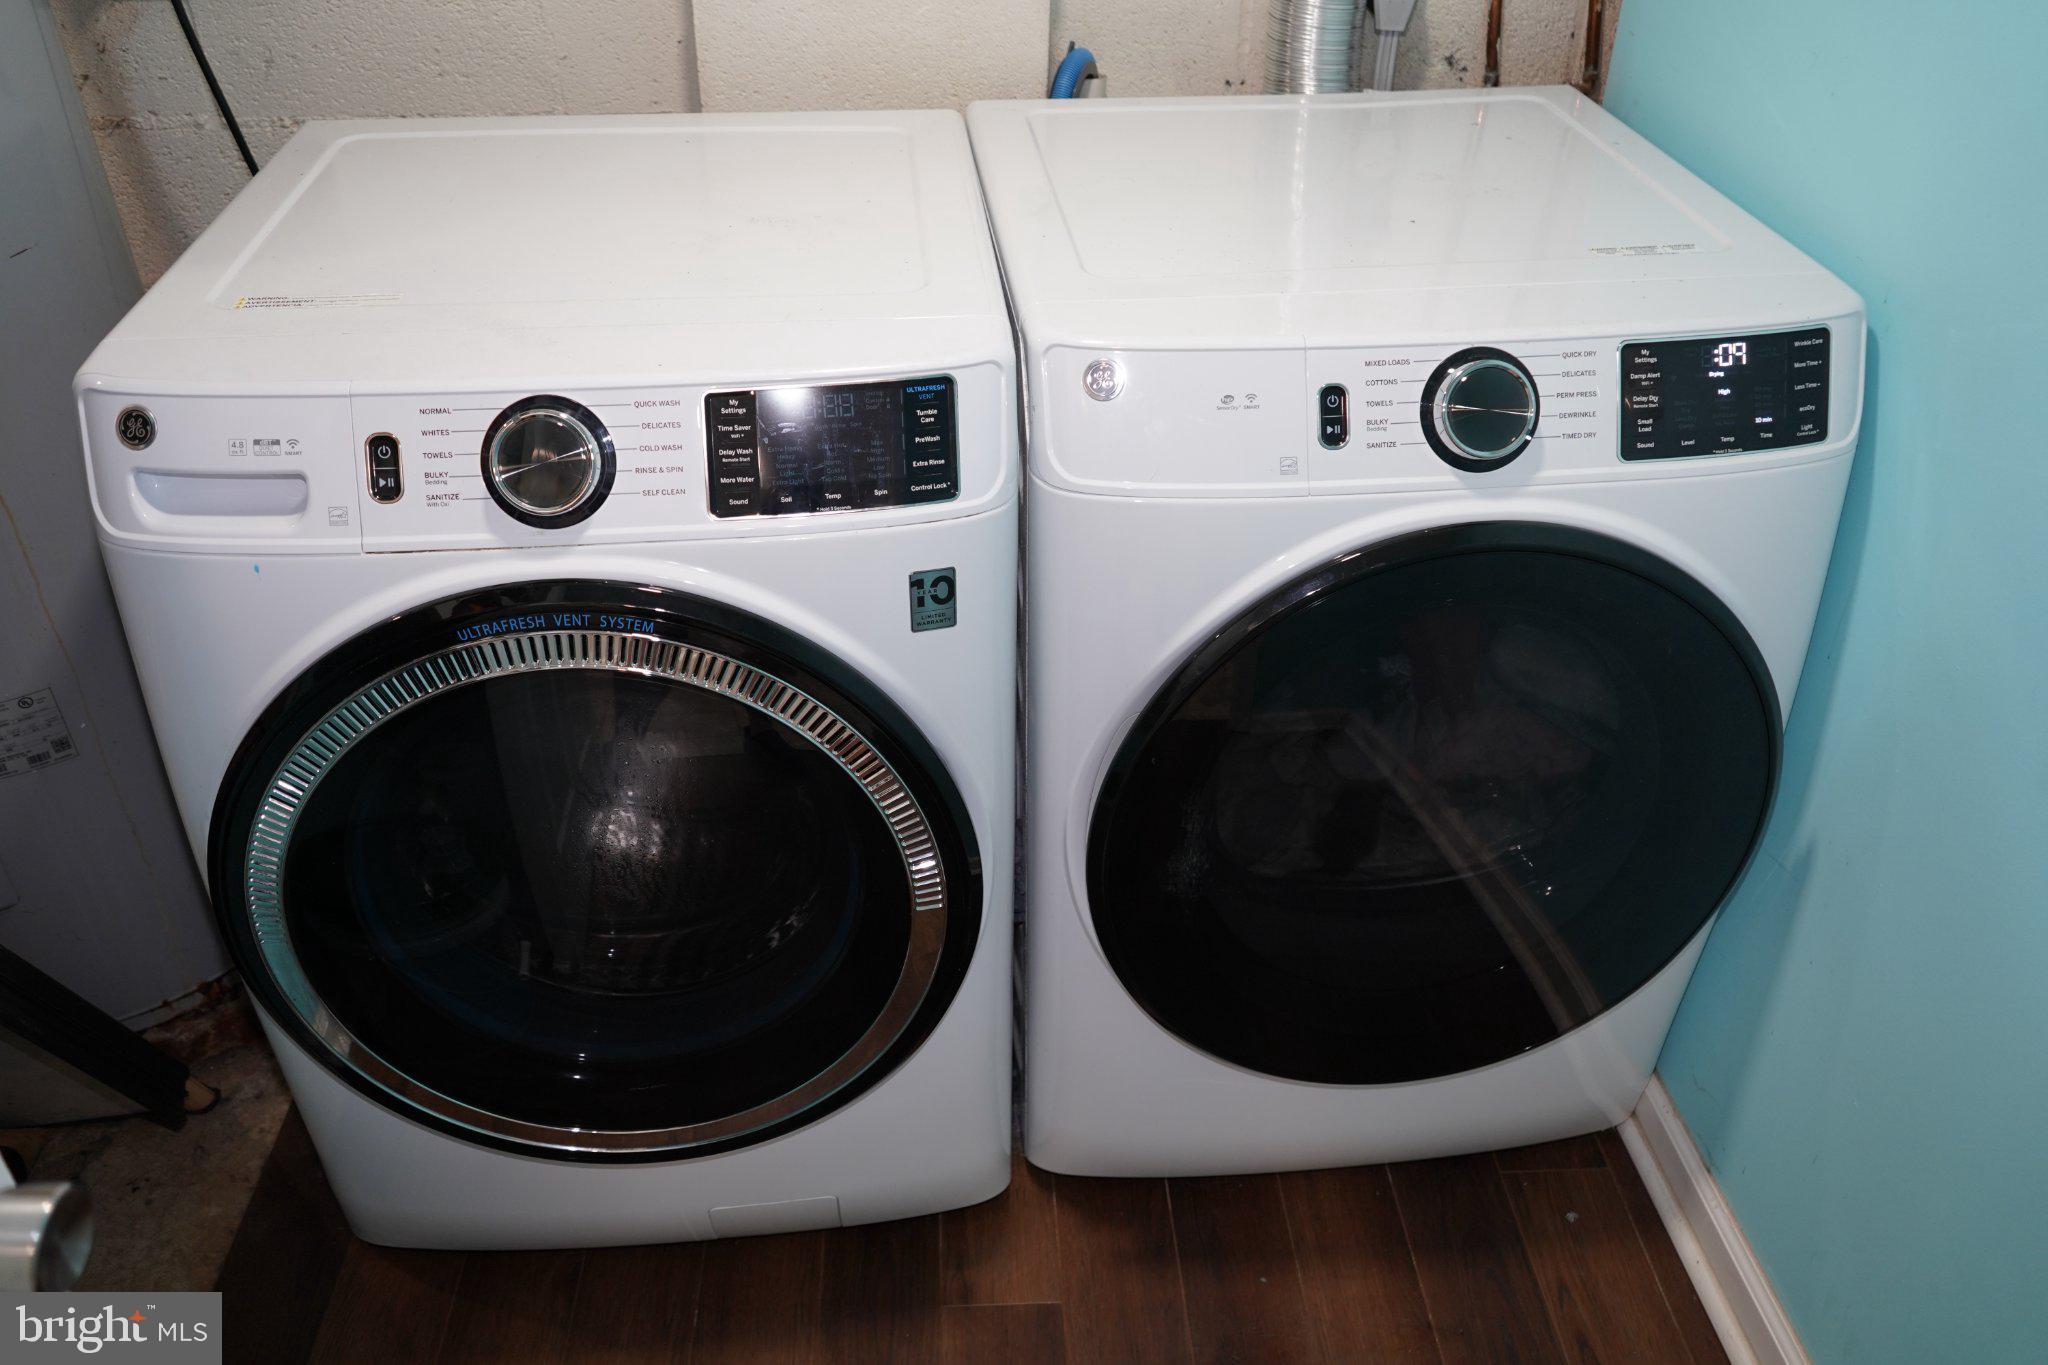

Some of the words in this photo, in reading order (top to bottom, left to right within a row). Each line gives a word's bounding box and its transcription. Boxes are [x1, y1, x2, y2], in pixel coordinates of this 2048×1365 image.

[906, 384, 946, 392] ULTRAFRESH
[911, 484, 933, 492] Control
[911, 576, 954, 607] 10
[457, 615, 546, 641] ULTRAFRESH
[552, 614, 591, 627] VENT
[600, 616, 655, 633] SYSTEM
